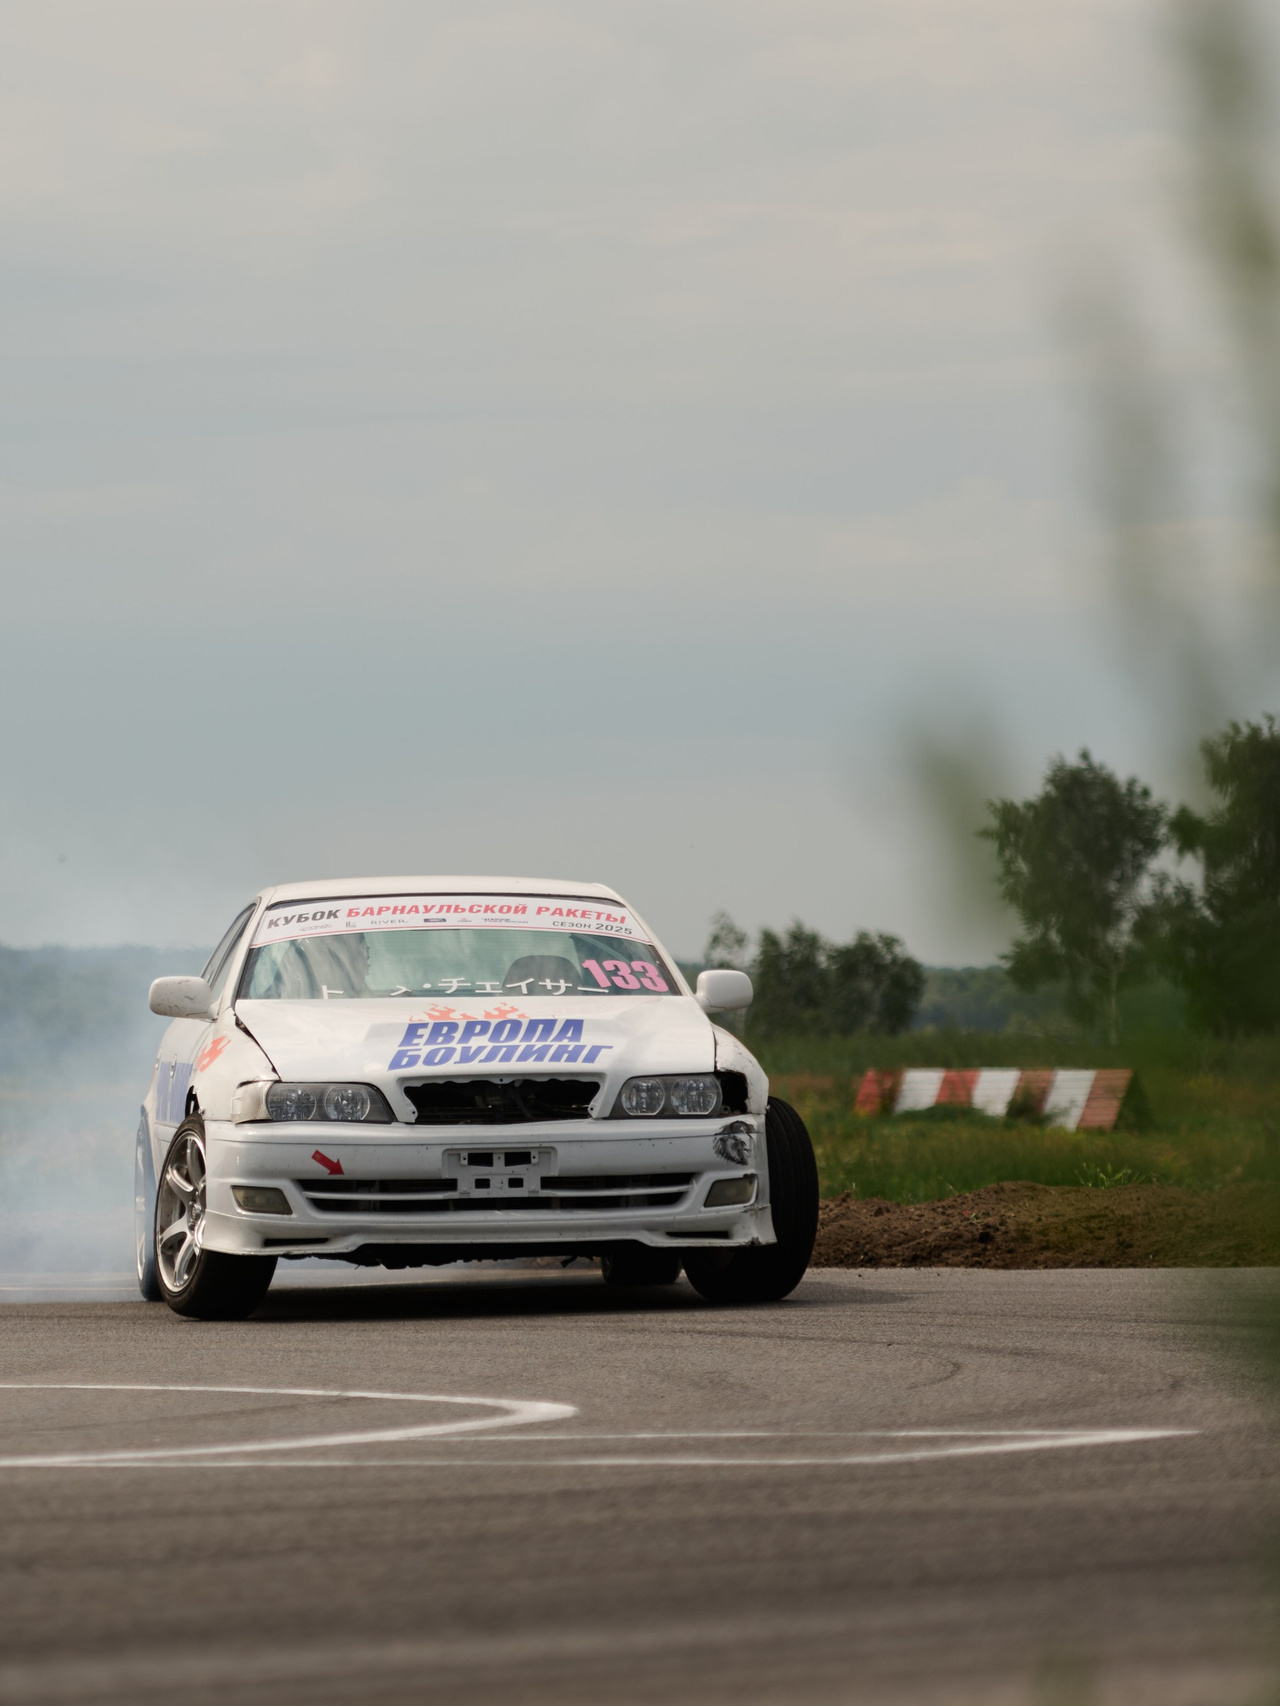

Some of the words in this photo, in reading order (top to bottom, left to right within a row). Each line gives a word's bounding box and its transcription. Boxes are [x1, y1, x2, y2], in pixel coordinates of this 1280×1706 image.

[267, 909, 341, 929] КУБОК
[347, 904, 527, 918] БАРНАУЛЬСКОЙ
[536, 906, 626, 924] РАКЕТЫ
[552, 921, 591, 929] СЕЗОН
[595, 923, 632, 935] 2025
[581, 959, 669, 992] 133
[398, 1019, 584, 1048] ЕВРОПА
[388, 1046, 613, 1072] БОУЛИНГ
